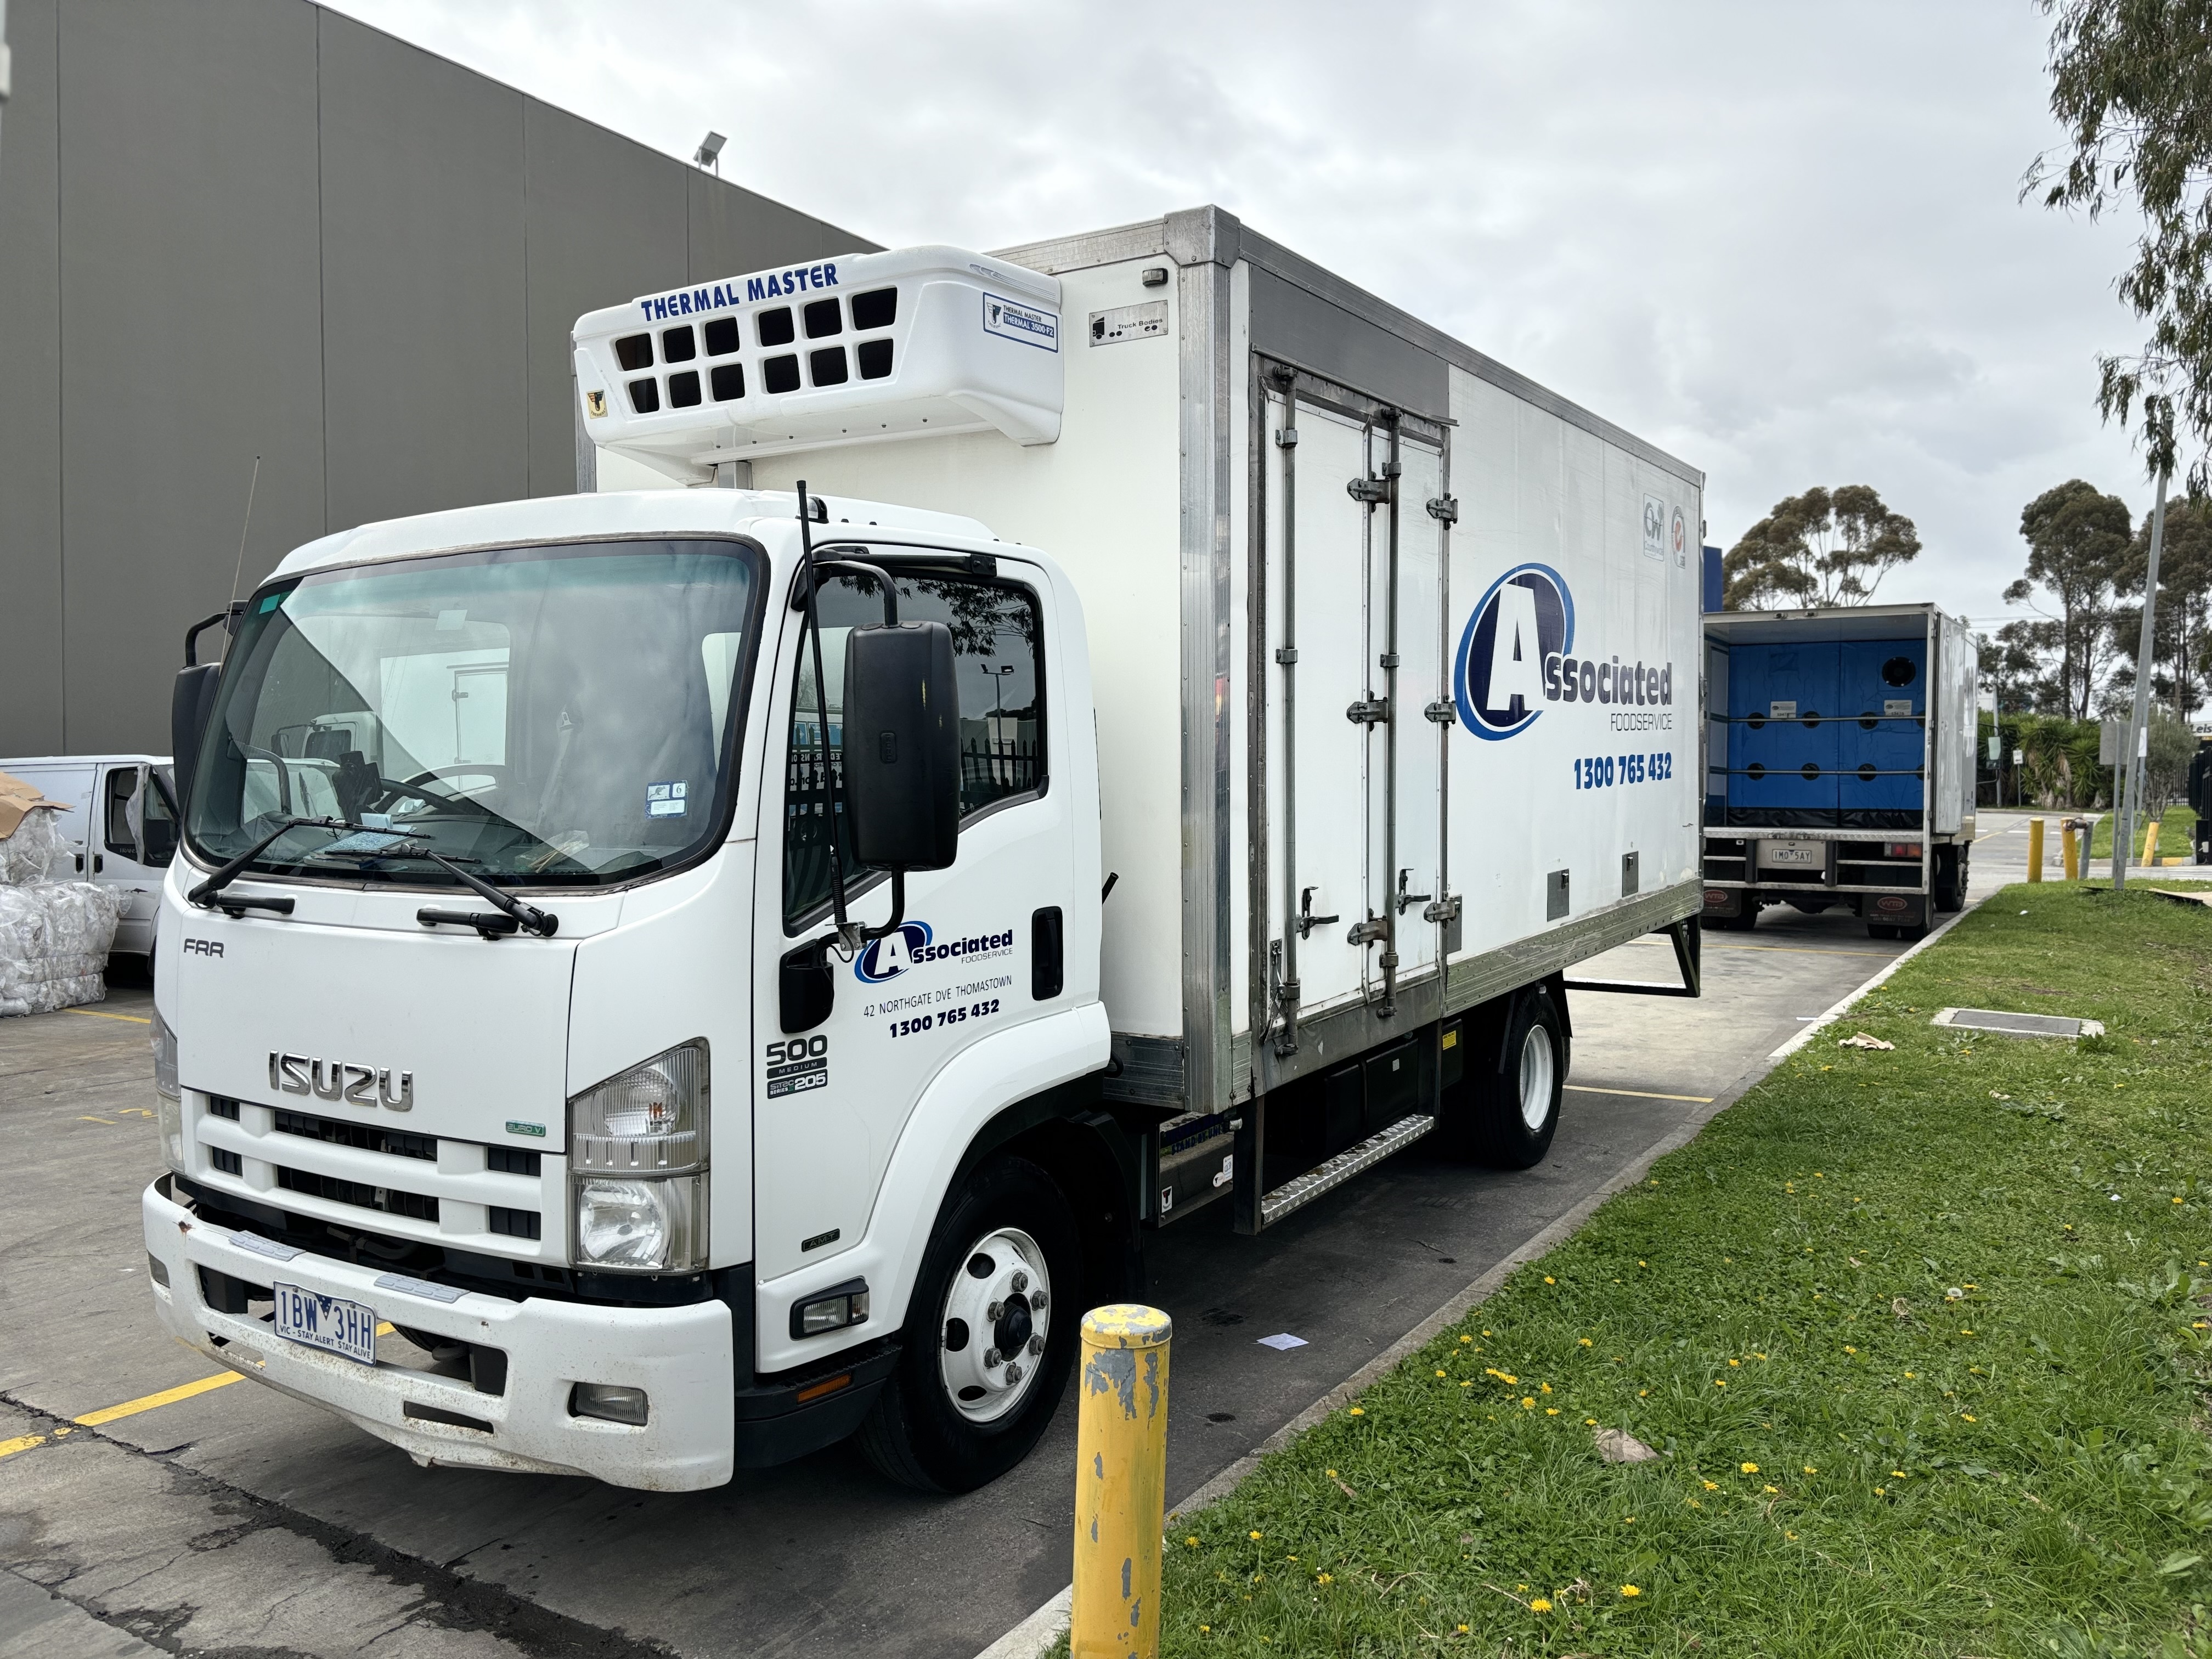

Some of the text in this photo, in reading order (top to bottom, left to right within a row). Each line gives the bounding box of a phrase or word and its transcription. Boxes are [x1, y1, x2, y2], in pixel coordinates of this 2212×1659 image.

[641, 263, 838, 321] THERMAL MASTER
[1003, 305, 1042, 322] THERMAL MASTER
[1005, 314, 1030, 329] THERMAL
[1487, 583, 1672, 712] Associated
[1611, 713, 1672, 731] FOODSERVICE
[1574, 752, 1672, 790] 1300 765 432
[676, 785, 682, 794] 6
[1795, 851, 1810, 860] 5AY
[184, 938, 224, 958] FRR
[874, 929, 1013, 976] Associated
[961, 947, 1013, 964] FOODSERVICE
[864, 975, 1012, 1018] 42 NORTHGATE DVE THOMASTOWN
[890, 999, 1000, 1038] 1300 765 432
[766, 1035, 827, 1066] 500
[779, 1062, 817, 1074] MEDIUM
[269, 1049, 414, 1111] ISUZU
[794, 1073, 826, 1090] 205
[770, 1087, 788, 1095] SERIES
[507, 1123, 532, 1132] EURO
[1172, 1125, 1222, 1155] STAND BY UNI
[809, 1233, 835, 1248] AMT
[281, 1291, 371, 1350] 1BW 3HH
[280, 1325, 291, 1335] VIC
[298, 1330, 313, 1340] STAY
[315, 1334, 334, 1346] ALERT
[338, 1341, 353, 1353] STAY
[353, 1347, 371, 1359] ALIVE
